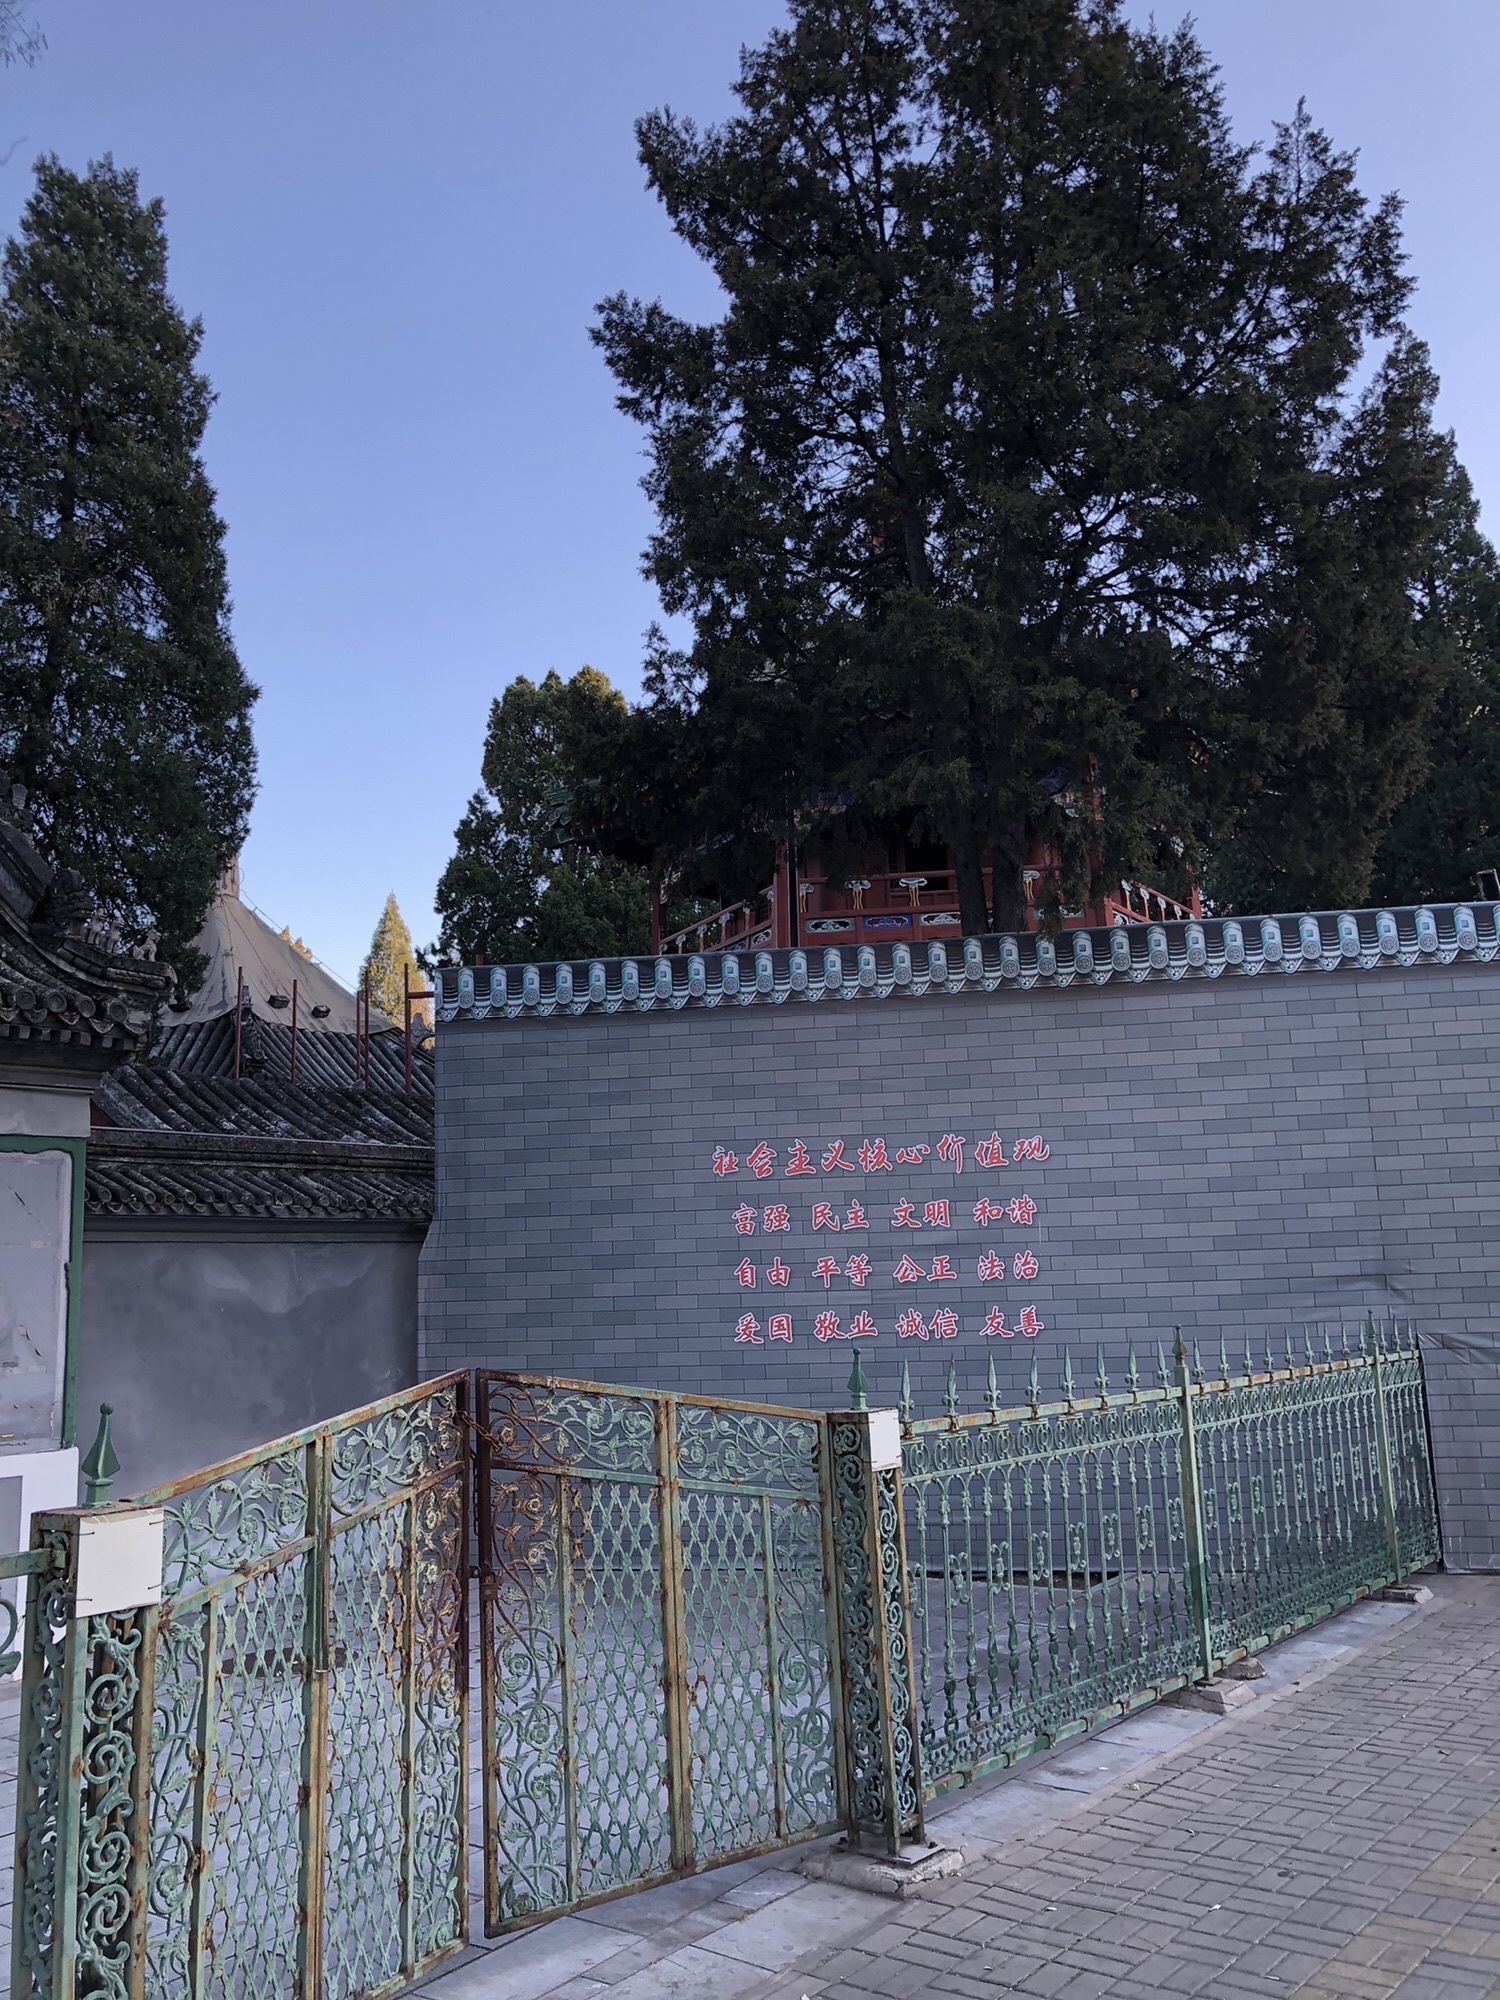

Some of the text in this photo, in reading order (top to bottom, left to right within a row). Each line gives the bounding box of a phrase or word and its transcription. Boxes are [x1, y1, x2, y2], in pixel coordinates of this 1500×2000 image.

[732, 1194, 1037, 1235] 富强 民主 文明 和谐
[734, 1250, 1039, 1288] 自由 平等 公正 法治
[734, 1304, 1044, 1344] 爱国 敬业 诚信 友善
